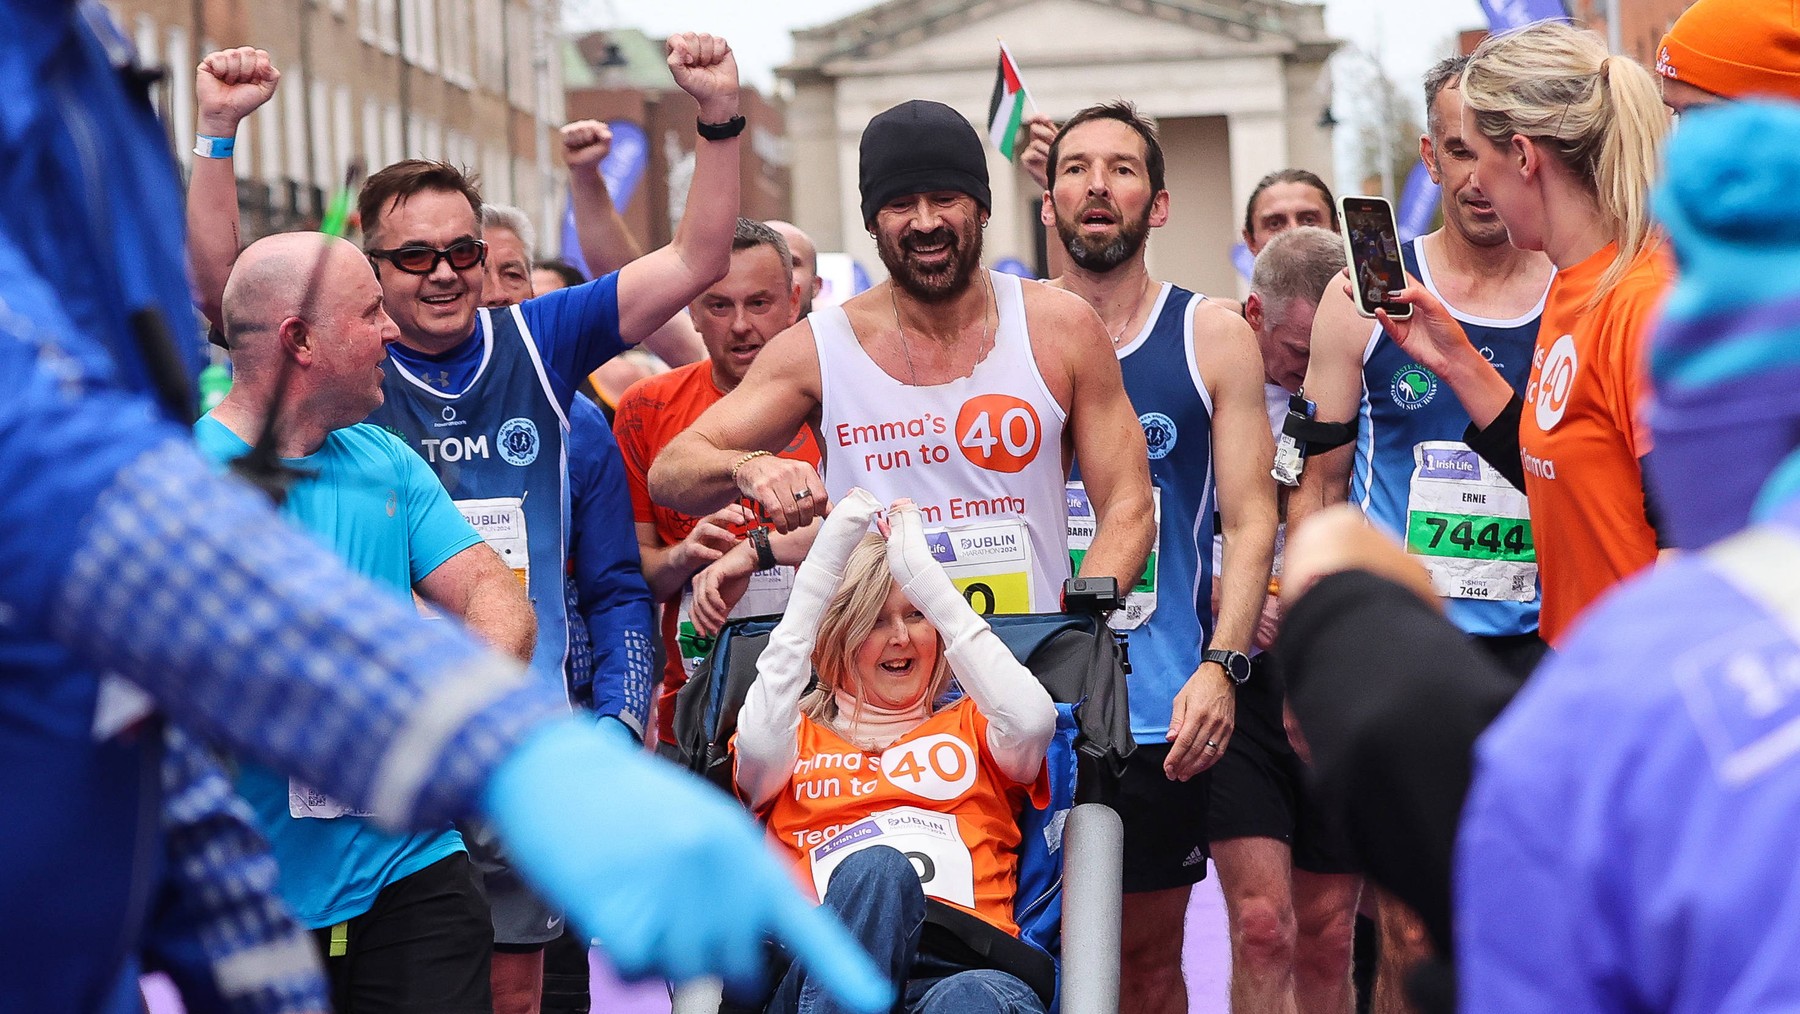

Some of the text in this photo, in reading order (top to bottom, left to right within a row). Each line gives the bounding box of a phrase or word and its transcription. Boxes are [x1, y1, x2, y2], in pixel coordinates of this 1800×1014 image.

[836, 413, 947, 447] Emma's
[961, 407, 1036, 459] 40
[421, 435, 490, 463] TOM
[865, 444, 950, 472] run to
[1436, 459, 1473, 471] Irish Life
[950, 496, 1025, 520] Emma
[1462, 492, 1487, 504] ERNIE
[961, 534, 1015, 550] DUBLIN
[1067, 527, 1094, 537] BARRY
[1426, 517, 1525, 554] 7444
[962, 548, 1000, 558] MARATHON
[1460, 586, 1488, 597] 7444
[889, 741, 967, 783] 40
[795, 777, 878, 801] run to
[792, 823, 851, 848] Tea
[888, 816, 944, 831] DUBLIN
[832, 828, 872, 847] Irish Life
